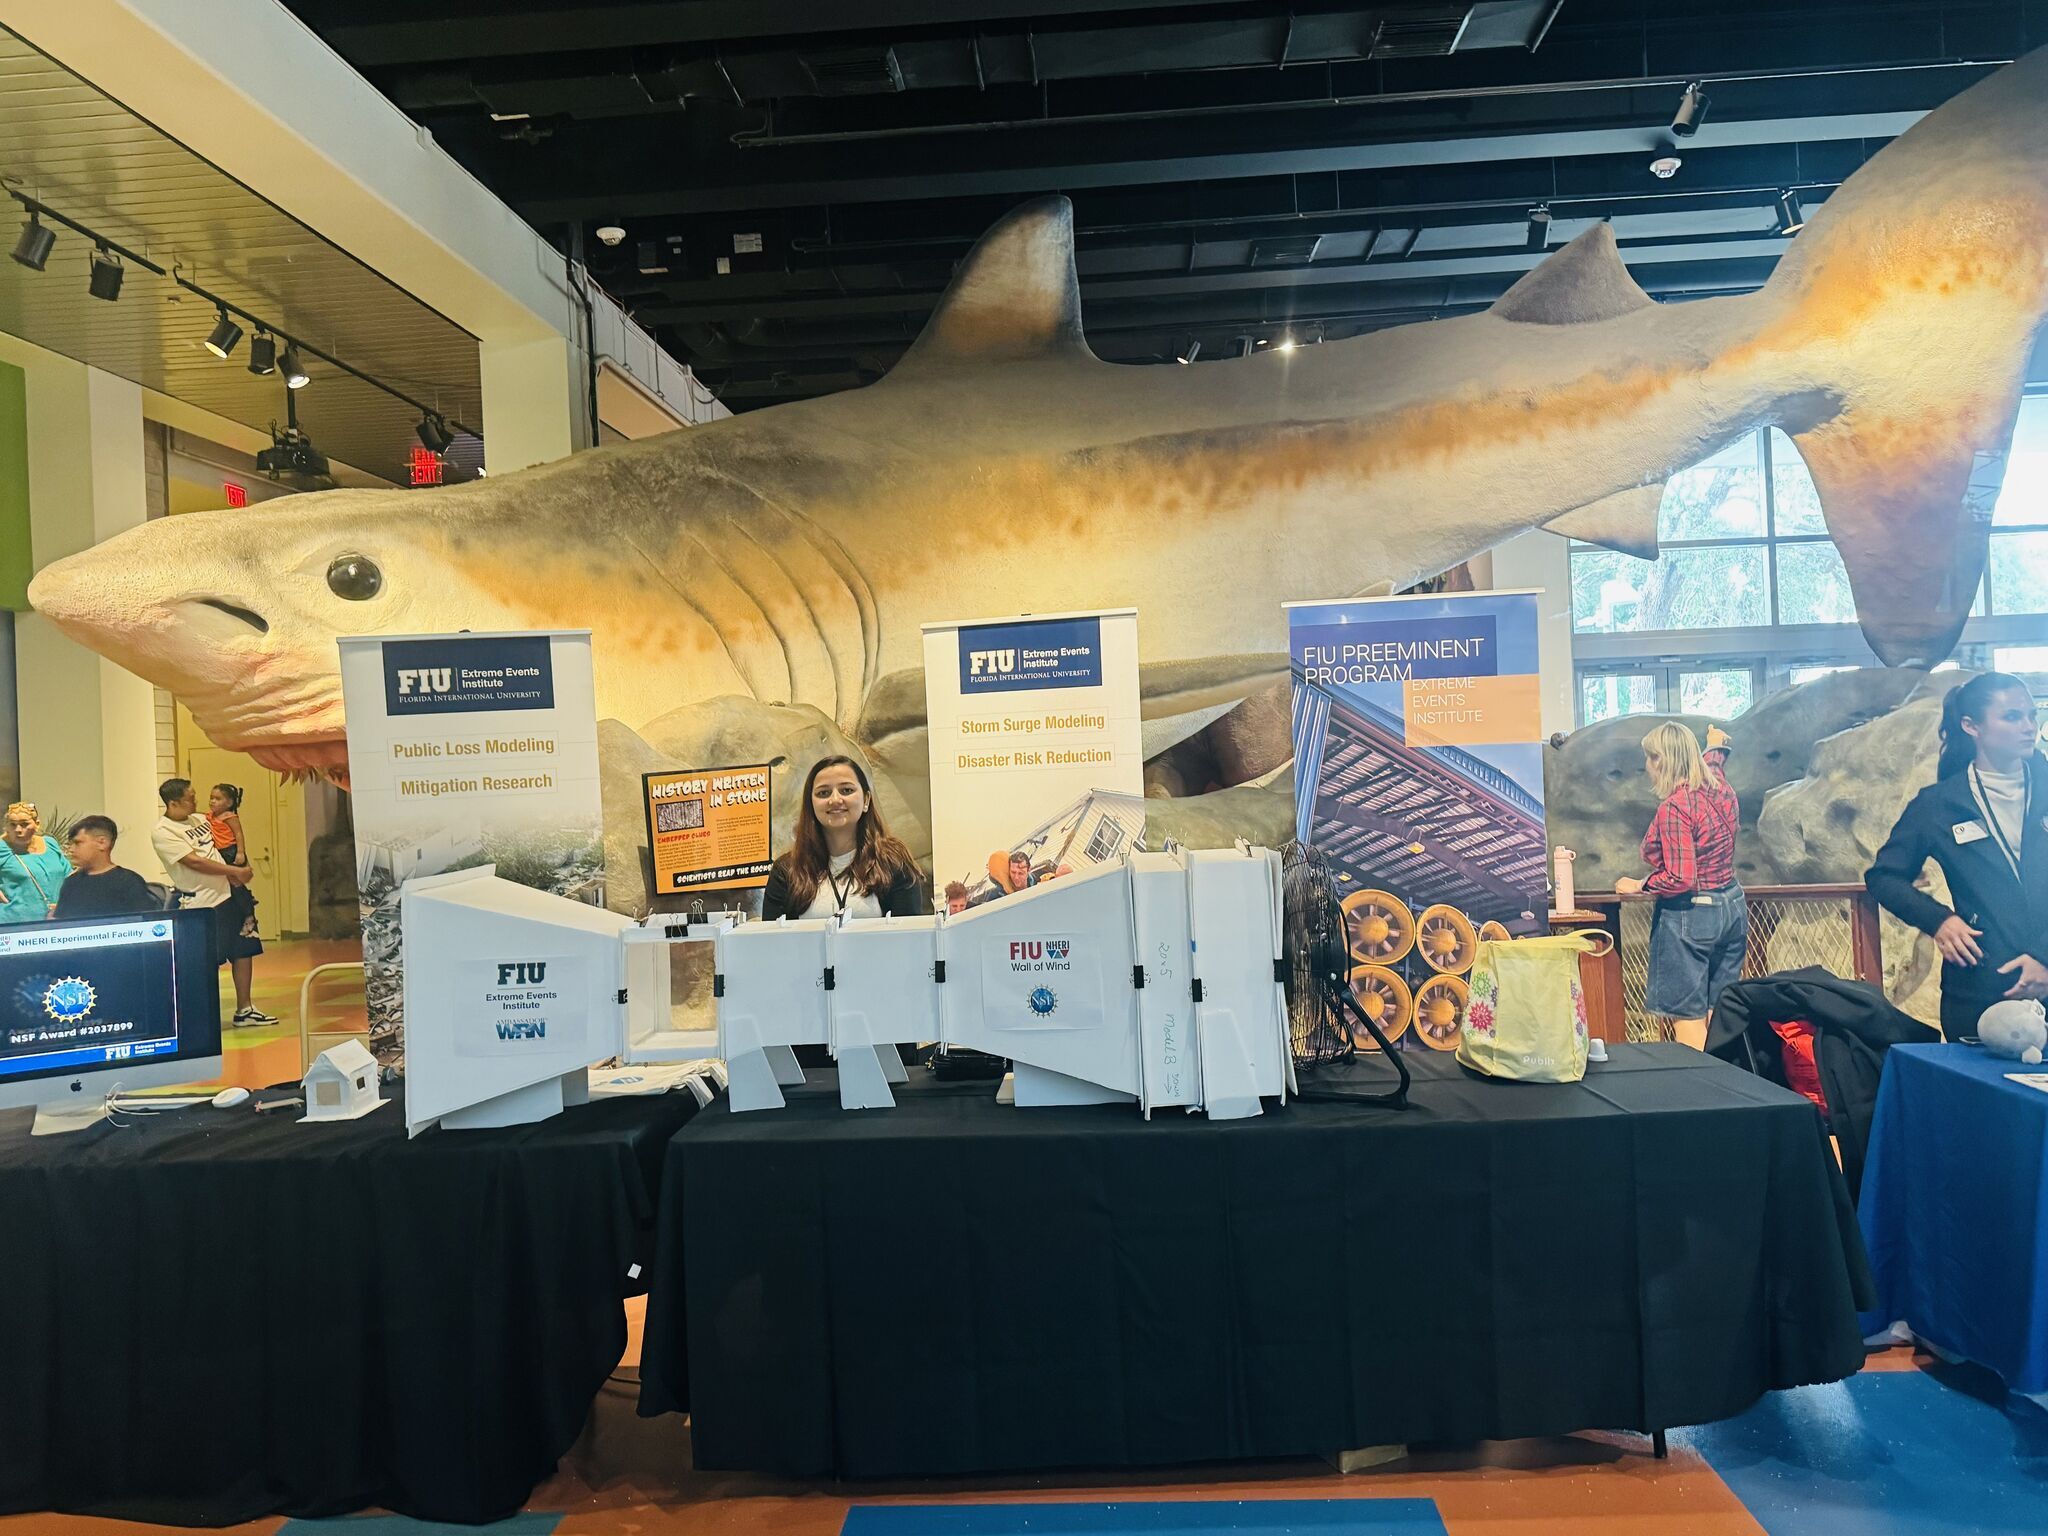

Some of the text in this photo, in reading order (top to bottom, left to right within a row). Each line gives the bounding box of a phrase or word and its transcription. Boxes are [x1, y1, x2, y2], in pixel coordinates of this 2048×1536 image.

[415, 465, 437, 482] EXIT
[1023, 647, 1090, 658] Extreme Events
[1304, 638, 1485, 665] FIU PREEMINENT
[970, 649, 1015, 674] FIU
[1023, 659, 1058, 668] Institute
[398, 668, 451, 694] FIU
[461, 667, 540, 678] Extreme Events
[970, 669, 1091, 683] FLORIDA INTERNATIONAL UNIVERSITY
[1304, 663, 1413, 686] PROGRAM
[462, 679, 503, 688] Institute
[1412, 676, 1476, 691] EXTREME
[399, 690, 541, 703] FLORIDA INTERNATIONAL UNIVERSITY
[1413, 694, 1465, 708] EVENTS
[961, 714, 1105, 734] Storm Surge Modeling
[1413, 710, 1483, 725] INSTITUTE
[394, 738, 554, 758] Public Loss Modeling
[958, 748, 1112, 768] Disaster Risk Reduction
[401, 774, 552, 796] Mitigation Research
[652, 772, 766, 799] HISTORY WRITTEN
[709, 787, 767, 808] IN STONE
[717, 868, 735, 878] READ
[736, 867, 749, 875] THE
[18, 928, 143, 946] NHERI Experimental Facility
[1010, 941, 1069, 960] FIU NHERI
[497, 962, 547, 985] FIU
[1011, 961, 1070, 971] Wall of Wind
[52, 991, 88, 1013] NSF
[486, 991, 558, 1001] Extreme Events
[503, 1002, 541, 1010] Institute
[11, 1033, 36, 1043] NSF
[39, 1029, 77, 1040] Award
[80, 1022, 134, 1035] #2037899
[105, 1045, 131, 1060] FIU
